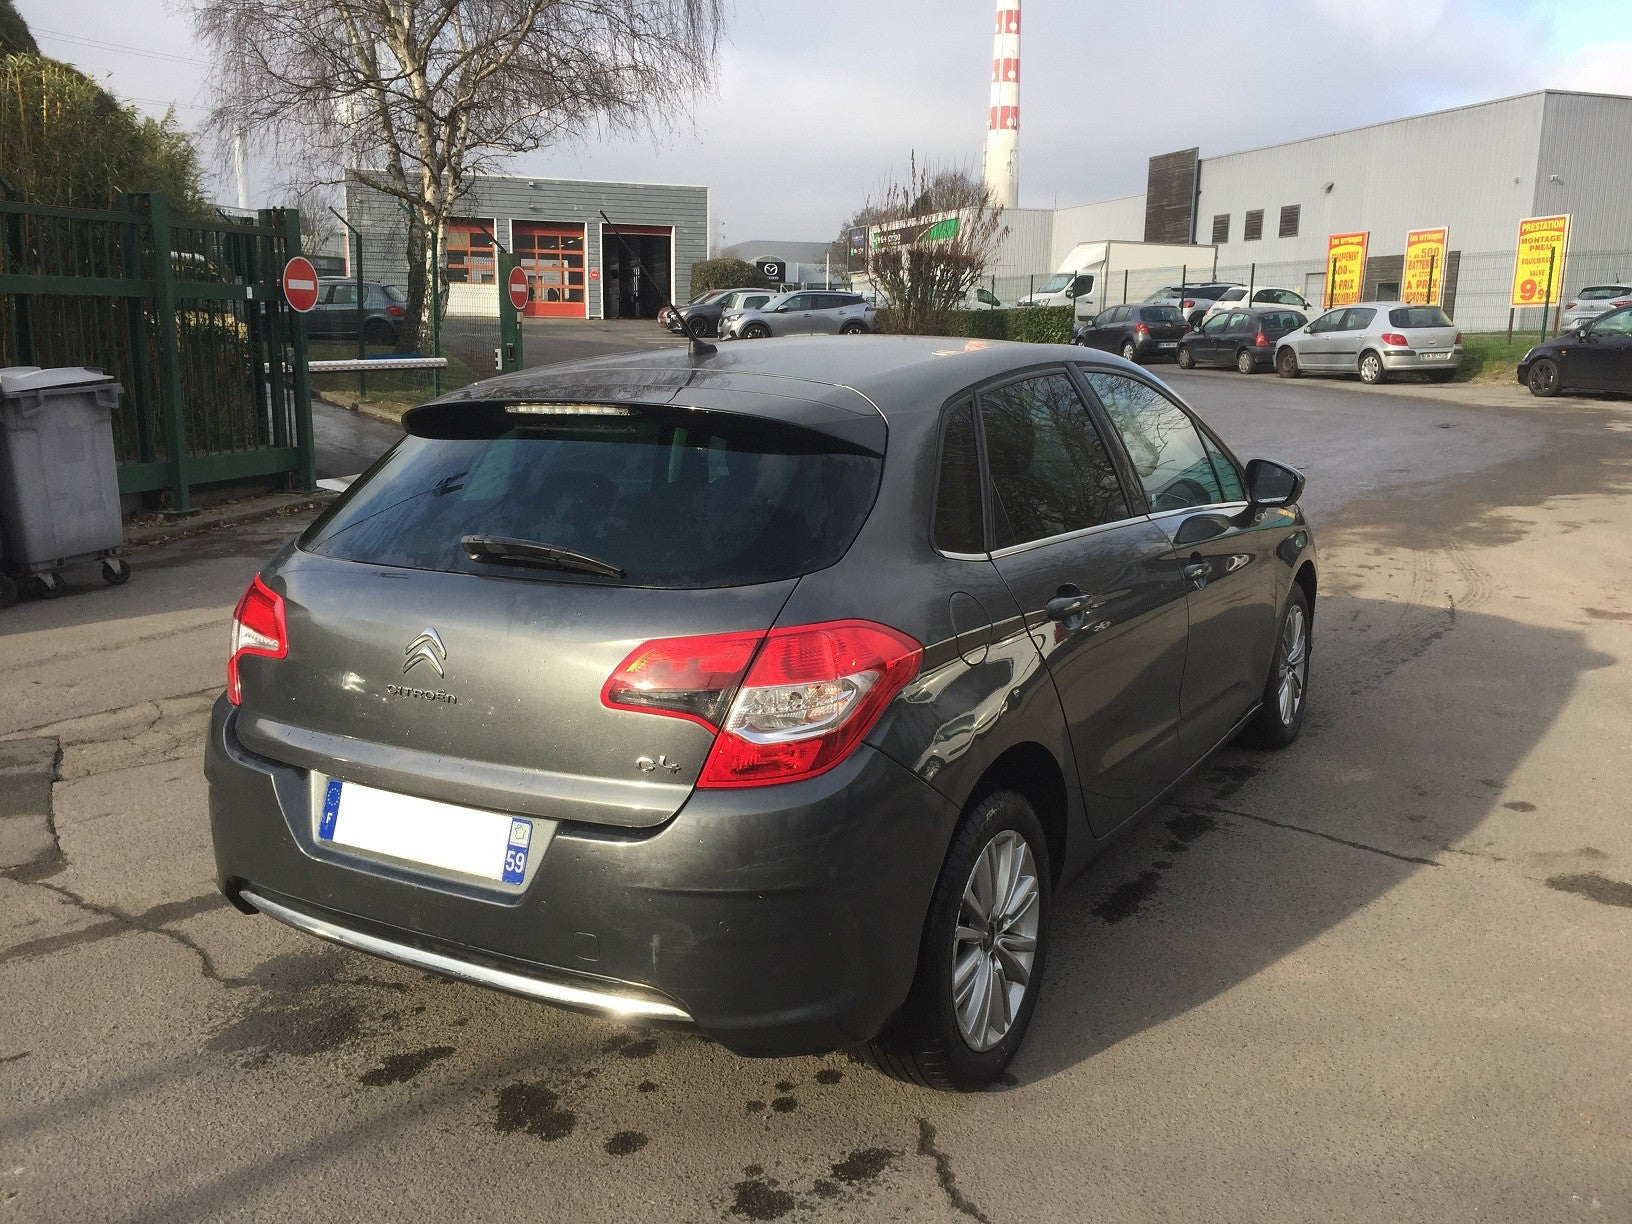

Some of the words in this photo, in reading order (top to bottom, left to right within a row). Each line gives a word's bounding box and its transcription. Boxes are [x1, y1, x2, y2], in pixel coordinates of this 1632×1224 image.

[1522, 220, 1565, 232] PRESTATION
[1521, 234, 1561, 244] MONTAGE
[1421, 247, 1440, 259] 500
[1339, 279, 1354, 290] PRIX
[1416, 279, 1438, 289] PRX
[1520, 279, 1537, 301] 9
[635, 754, 682, 775] C4
[325, 811, 334, 825] F
[505, 849, 526, 873] 59
